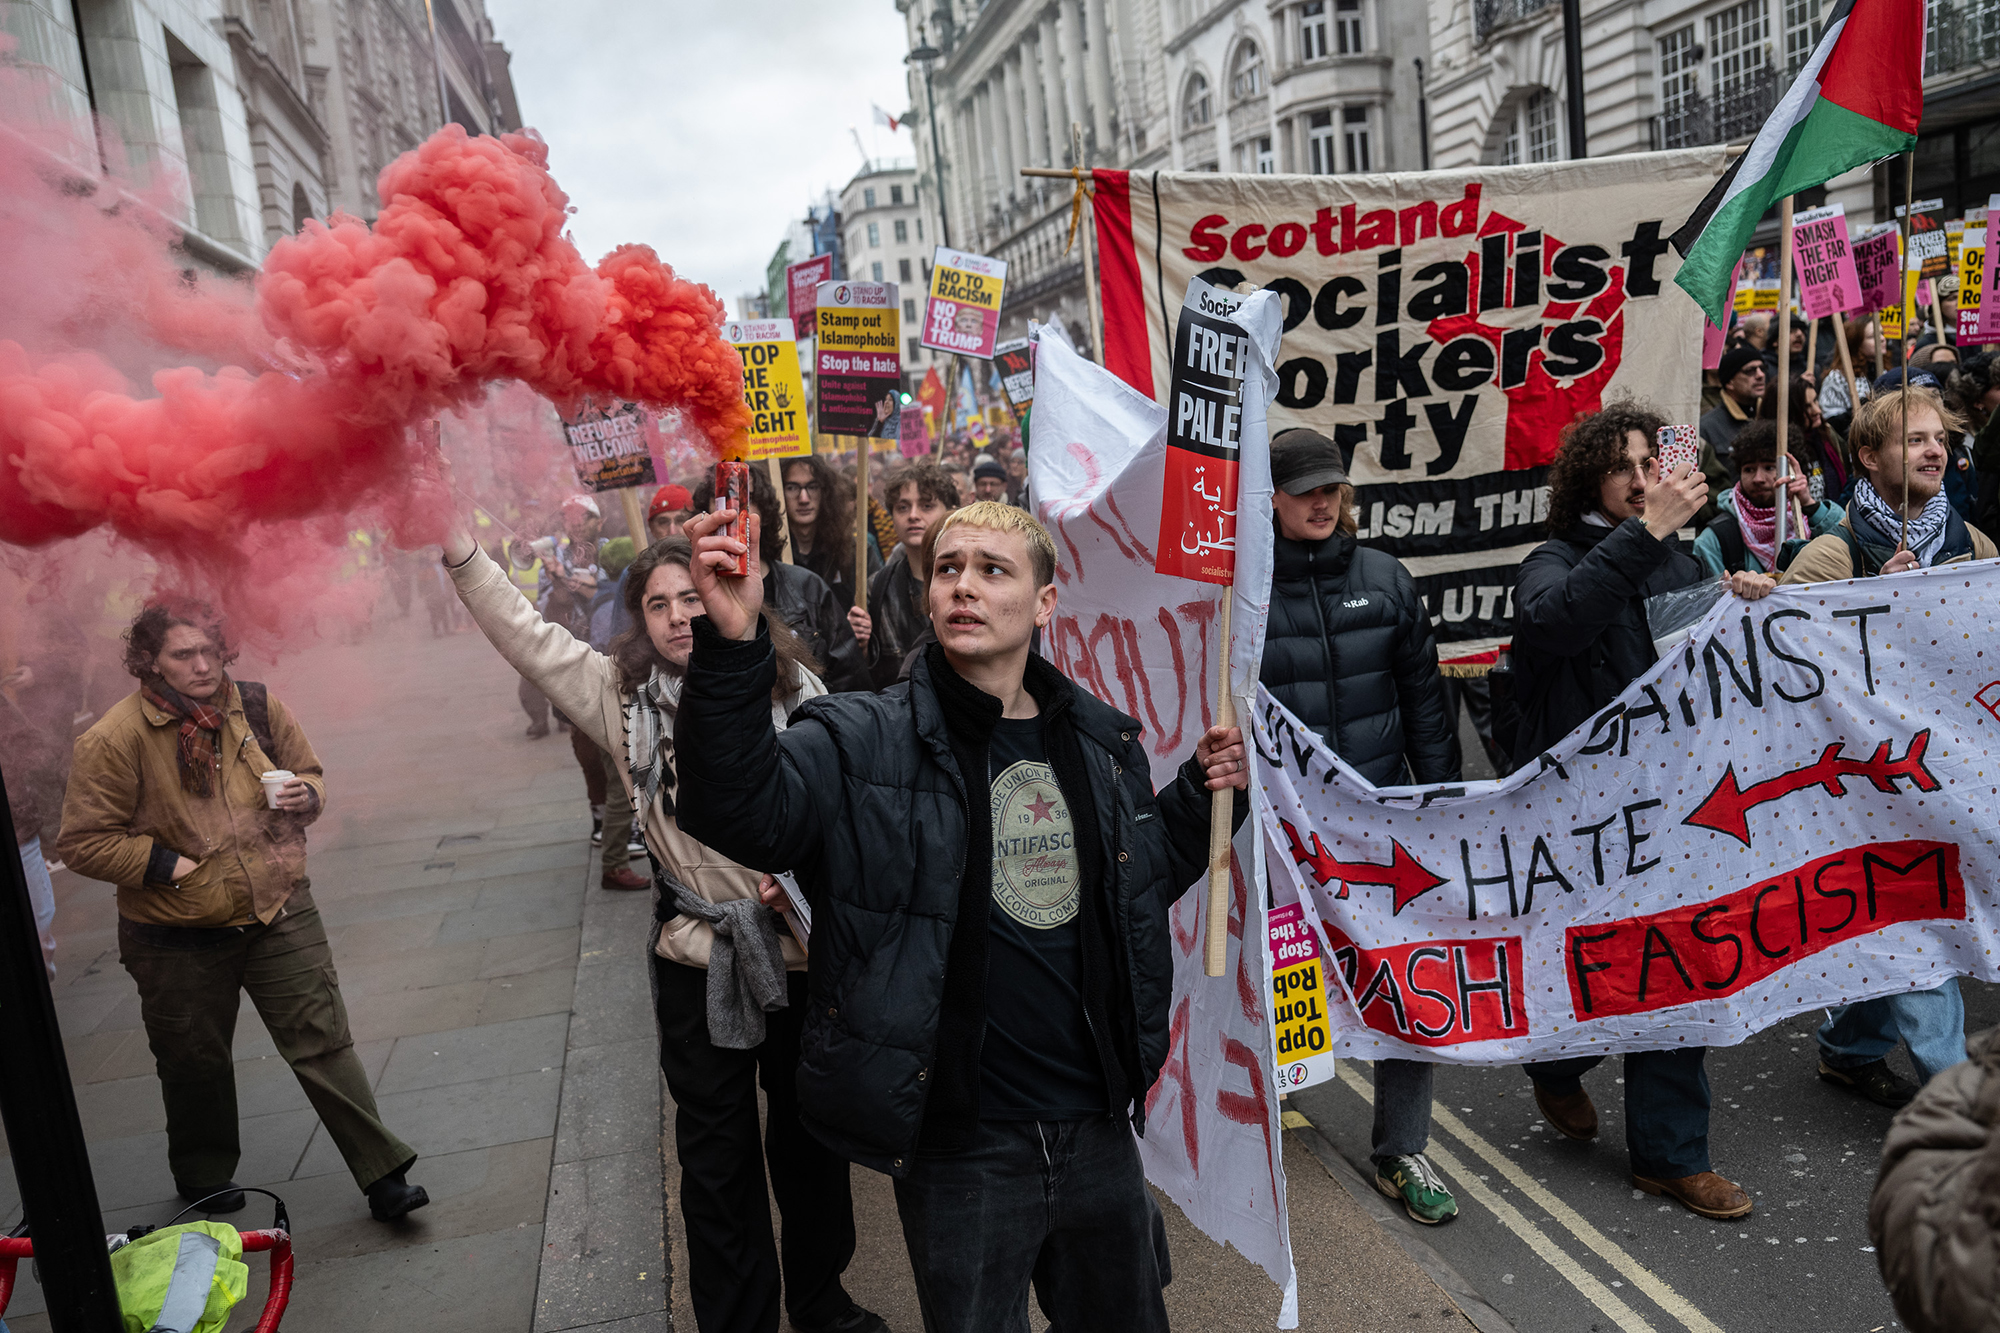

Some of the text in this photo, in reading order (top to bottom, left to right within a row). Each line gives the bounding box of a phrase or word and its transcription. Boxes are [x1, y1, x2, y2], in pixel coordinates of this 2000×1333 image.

[1182, 184, 1482, 262] Scotland
[1795, 221, 1836, 247] SMASH
[1798, 239, 1847, 267] THE FAR
[1853, 236, 1887, 262] MASH
[1856, 259, 1871, 275] HE
[1875, 250, 1895, 272] FAR
[940, 269, 983, 290] NO TO
[1196, 221, 1669, 334] ocialist
[1803, 261, 1840, 288] RIGHT
[1860, 269, 1884, 290] GHT
[853, 287, 883, 295] STAND UP
[862, 296, 887, 305] RACISM
[937, 283, 993, 306] RACISM
[933, 300, 956, 318] NO
[744, 324, 777, 333] STAND UP
[821, 312, 881, 331] Stamp out
[933, 315, 953, 331] TO
[756, 331, 780, 339] RACISM
[822, 330, 895, 349] Islamophobia
[930, 328, 983, 351] TRUMP
[737, 344, 779, 367] TOP
[1187, 322, 1248, 379] FREE
[822, 354, 896, 374] Stop the hate
[1274, 319, 1606, 410] orkers
[744, 368, 769, 390] HE
[821, 380, 867, 392] Unite against
[744, 391, 770, 412] AR
[821, 392, 867, 403] Islamophobia
[829, 404, 873, 415] antisemitism
[1177, 391, 1242, 449] PALE
[568, 414, 639, 445] REFUGEES
[750, 411, 796, 434] GHT
[750, 434, 799, 446] Islamophobia
[752, 445, 800, 456] antisemitism
[1350, 597, 1369, 608] Rab
[991, 789, 1006, 829] RADE
[1003, 768, 1041, 789] UNION
[1018, 809, 1068, 824] 19 36
[994, 831, 1072, 858] NTIFASC
[1460, 799, 1662, 921] HATE
[1024, 875, 1068, 888] ORIGINAL
[995, 881, 1046, 922] ALCOHOL
[1270, 922, 1296, 942] the
[1574, 846, 1950, 1014] FASCISM
[1278, 939, 1313, 958] Stop
[1273, 965, 1318, 999] Rob
